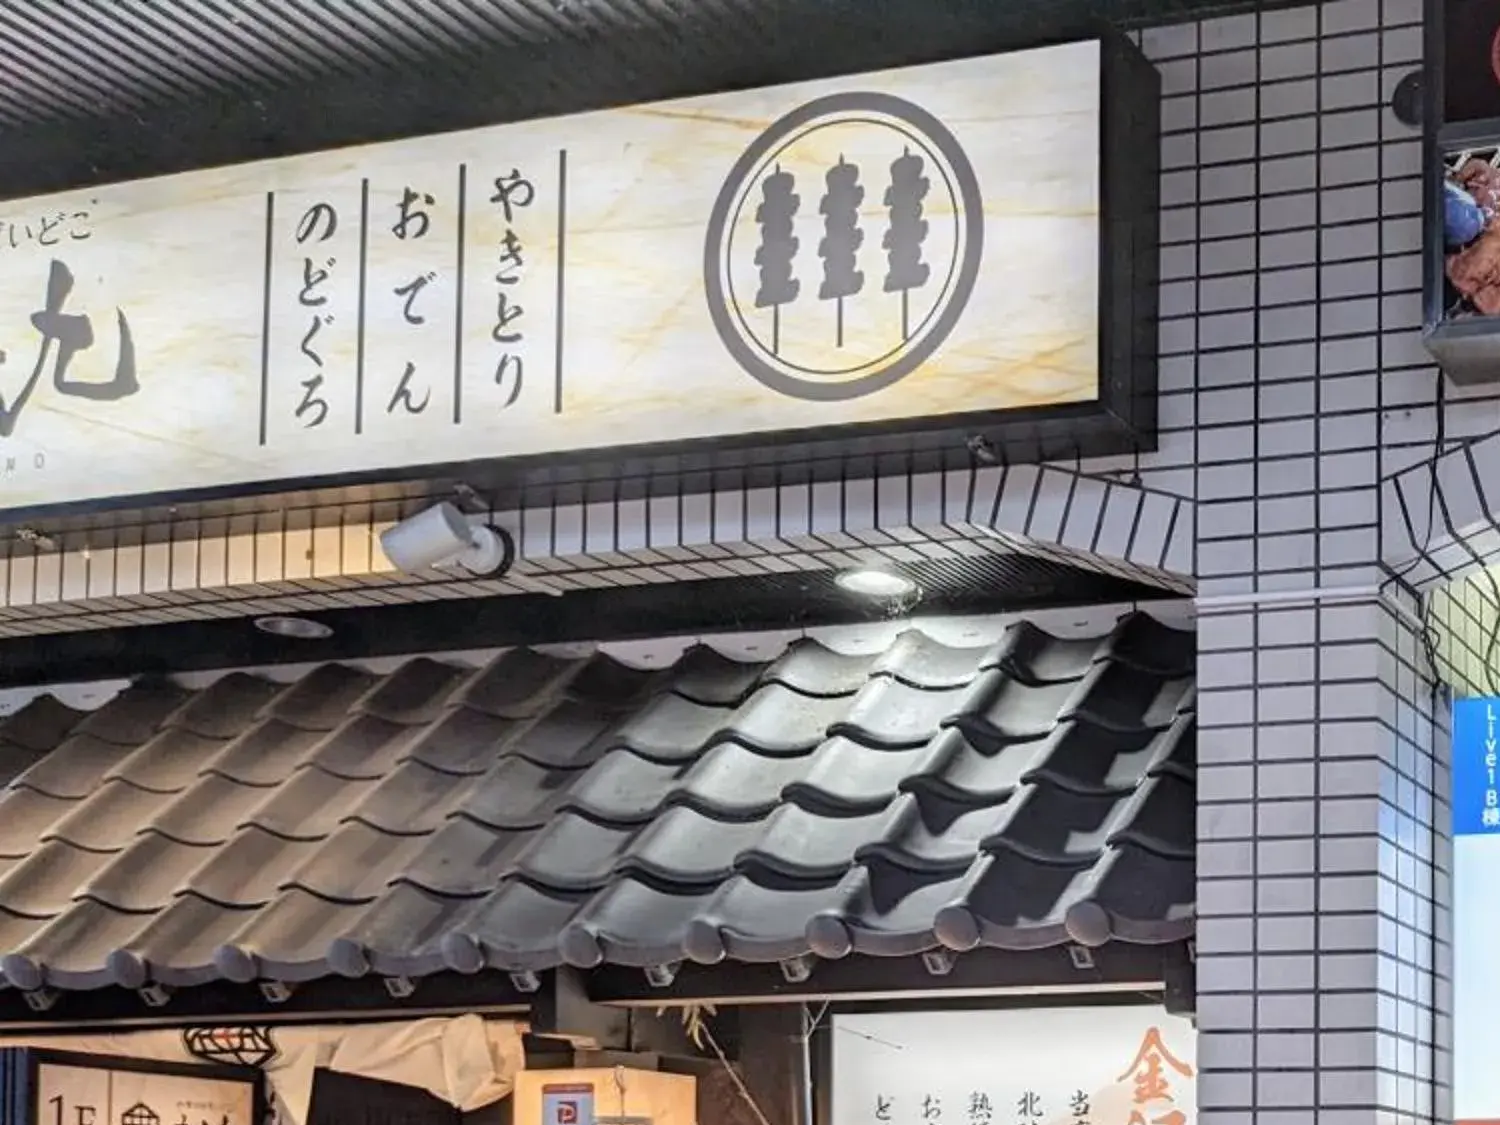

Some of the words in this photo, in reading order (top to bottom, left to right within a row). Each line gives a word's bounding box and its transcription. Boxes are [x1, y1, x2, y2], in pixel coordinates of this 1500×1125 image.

[293, 200, 338, 428] のどぐろ
[390, 188, 432, 415] おでん
[488, 167, 534, 408] やきとり
[1486, 705, 1500, 785] Live1
